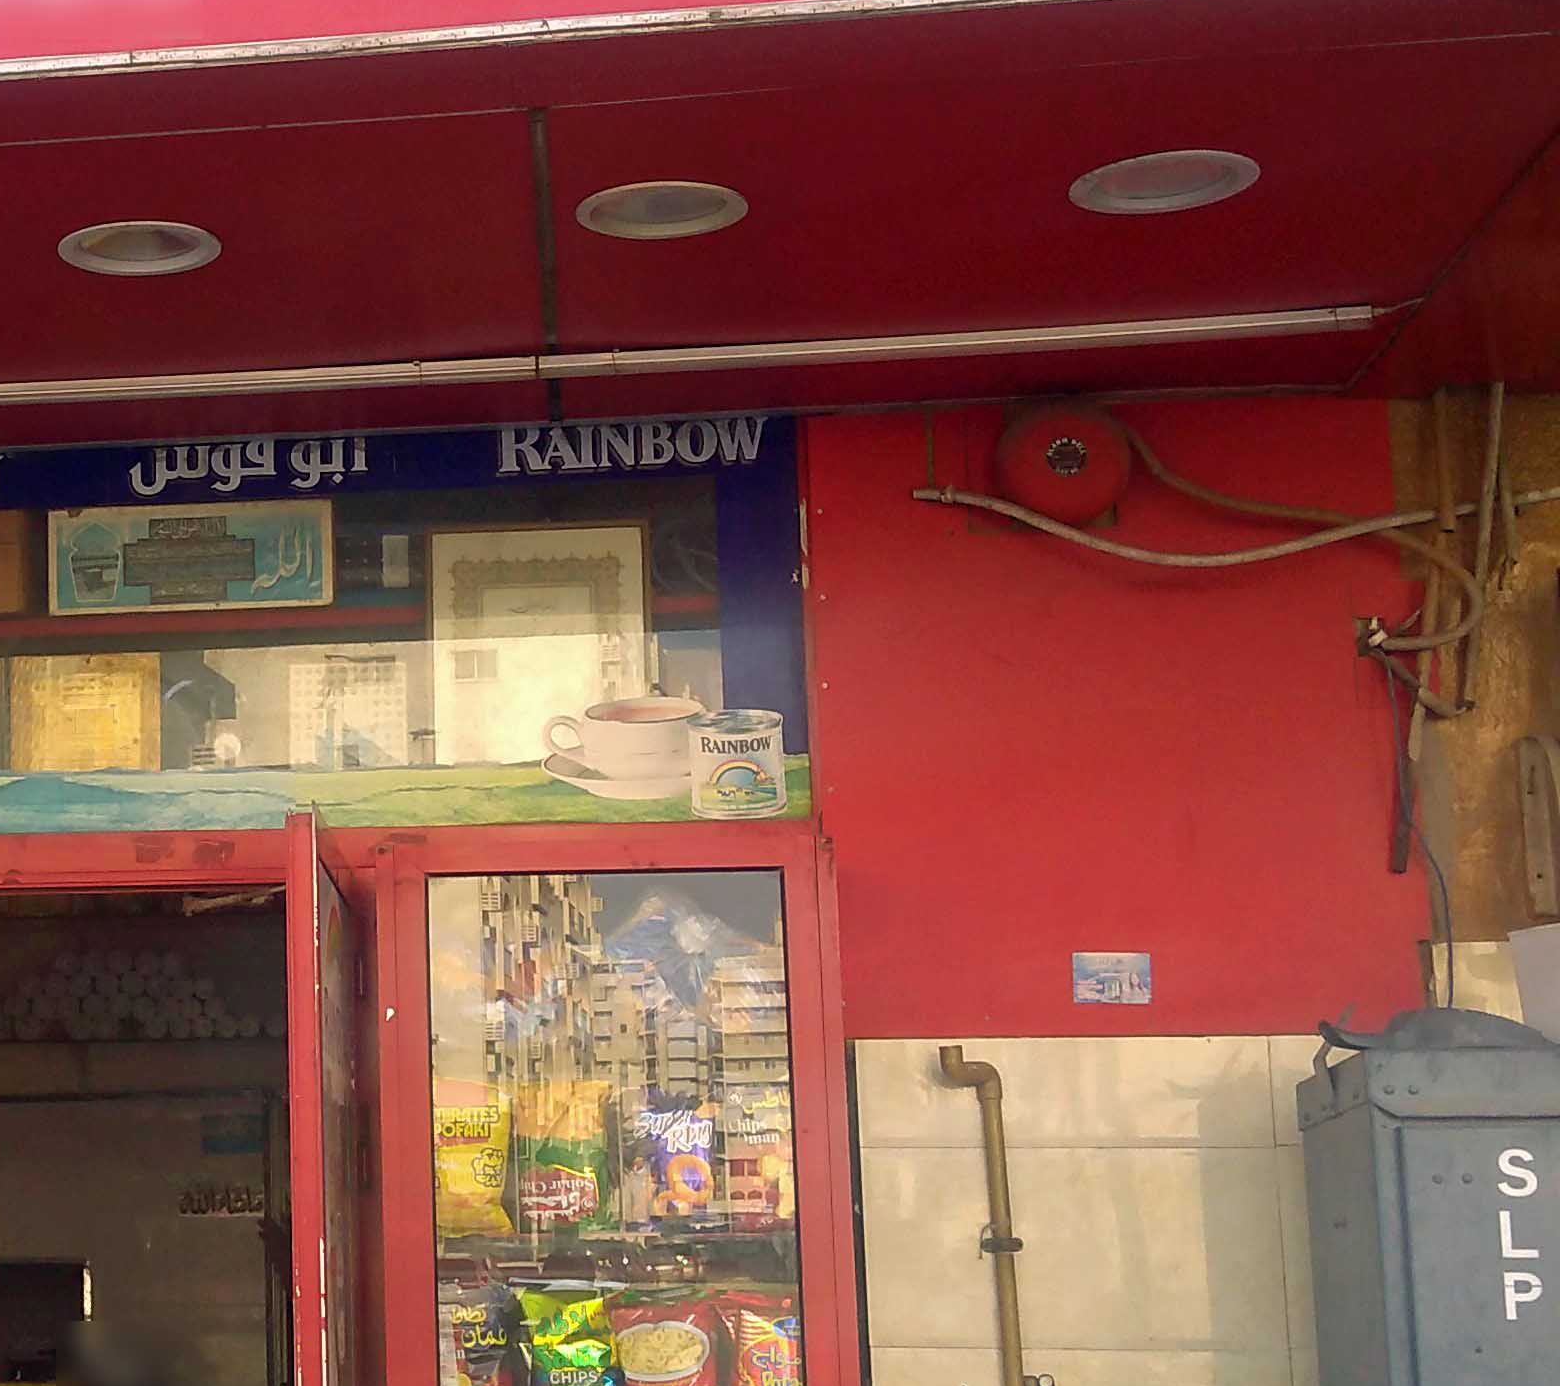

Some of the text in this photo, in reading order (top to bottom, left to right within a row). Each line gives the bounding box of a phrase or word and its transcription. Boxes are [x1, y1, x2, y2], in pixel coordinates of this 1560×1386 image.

[497, 416, 769, 476] RAINBOW
[700, 735, 773, 755] RAINBOW
[549, 1370, 599, 1385] CHIPS
